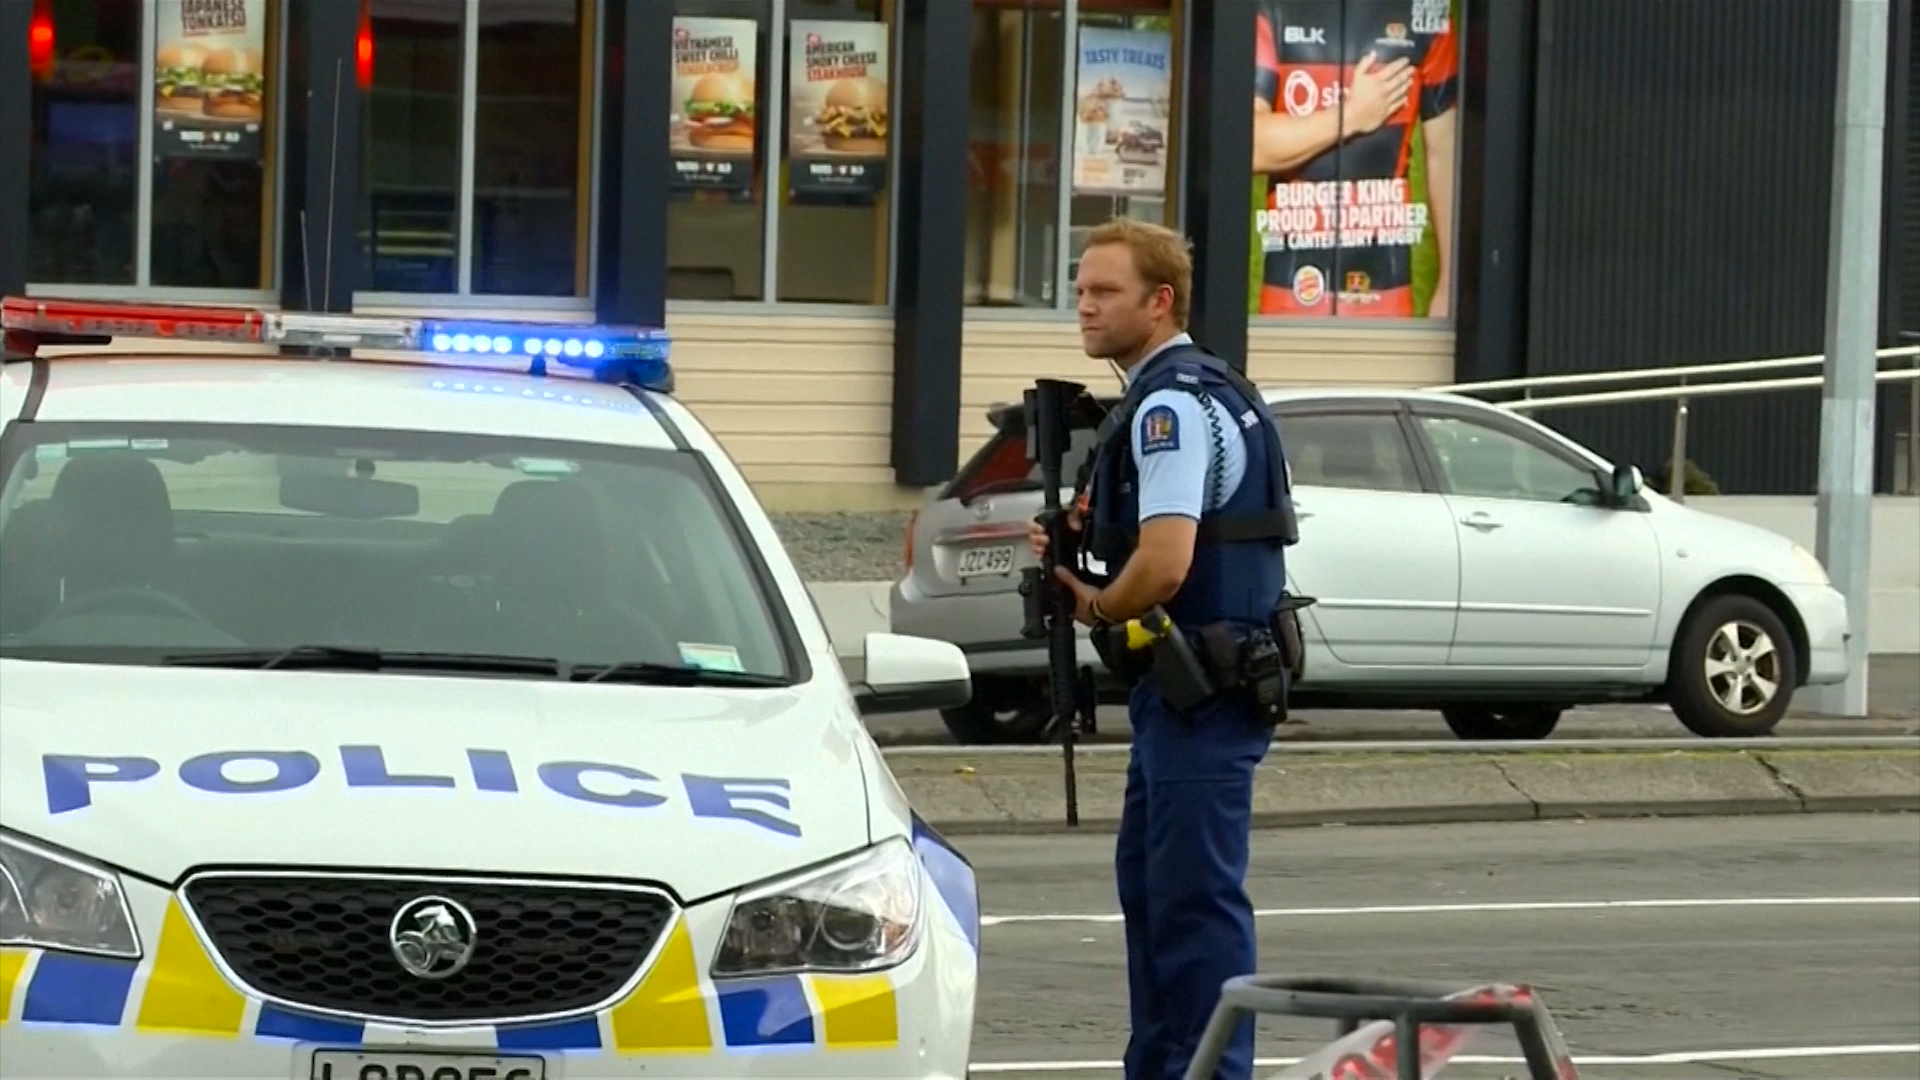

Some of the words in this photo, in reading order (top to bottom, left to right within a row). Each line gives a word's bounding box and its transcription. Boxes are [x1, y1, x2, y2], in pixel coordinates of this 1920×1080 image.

[182, 11, 246, 30] TONKATSU
[1284, 26, 1326, 44] BLK
[675, 50, 706, 63] SWEET
[709, 48, 738, 61] CHILLI
[806, 41, 854, 54] AMERICAN
[806, 54, 839, 67] SMOKY
[842, 52, 877, 65] CHEESE
[1085, 49, 1119, 64] TASTY
[1122, 48, 1165, 70] TREATS
[808, 65, 866, 81] STEAKHOUSE
[1357, 178, 1407, 203] KING
[1256, 208, 1317, 233] PROUD
[1350, 202, 1428, 228] PARTNER
[1378, 226, 1424, 245] RUGBY
[42, 744, 802, 837] POLICE
